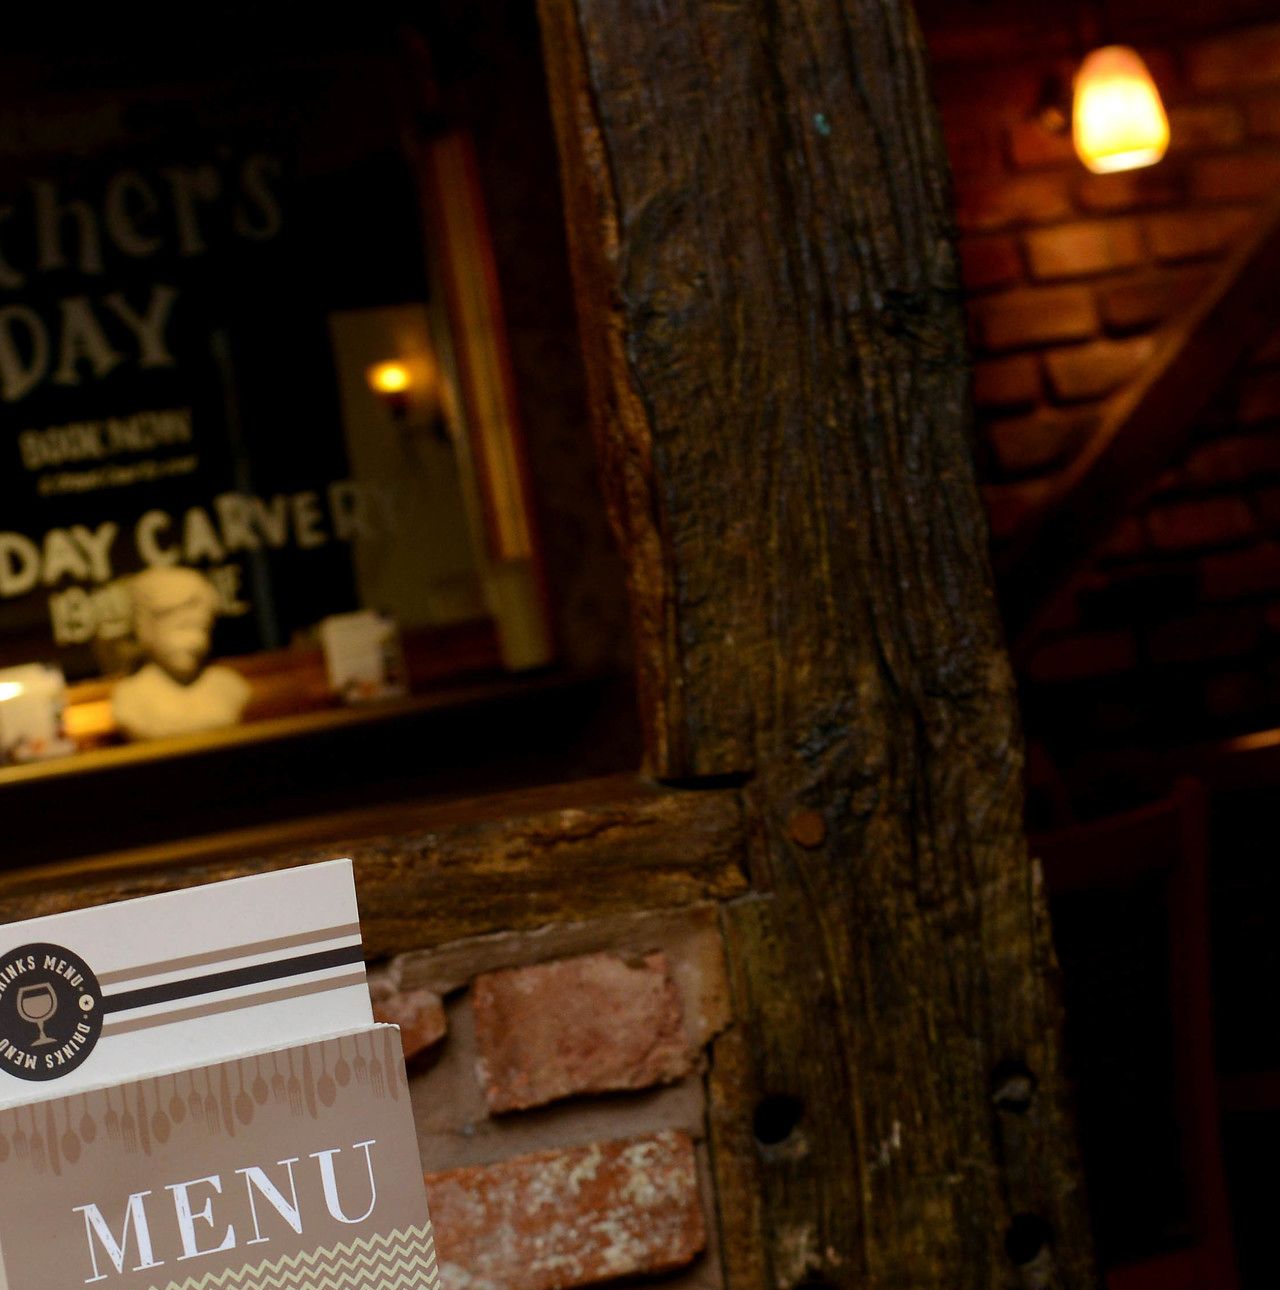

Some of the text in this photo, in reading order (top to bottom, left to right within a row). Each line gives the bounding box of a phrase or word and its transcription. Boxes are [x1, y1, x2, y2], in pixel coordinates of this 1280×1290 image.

[43, 954, 84, 988] MENU
[45, 1022, 91, 1069] DRINKS
[72, 1139, 376, 1283] MENU
